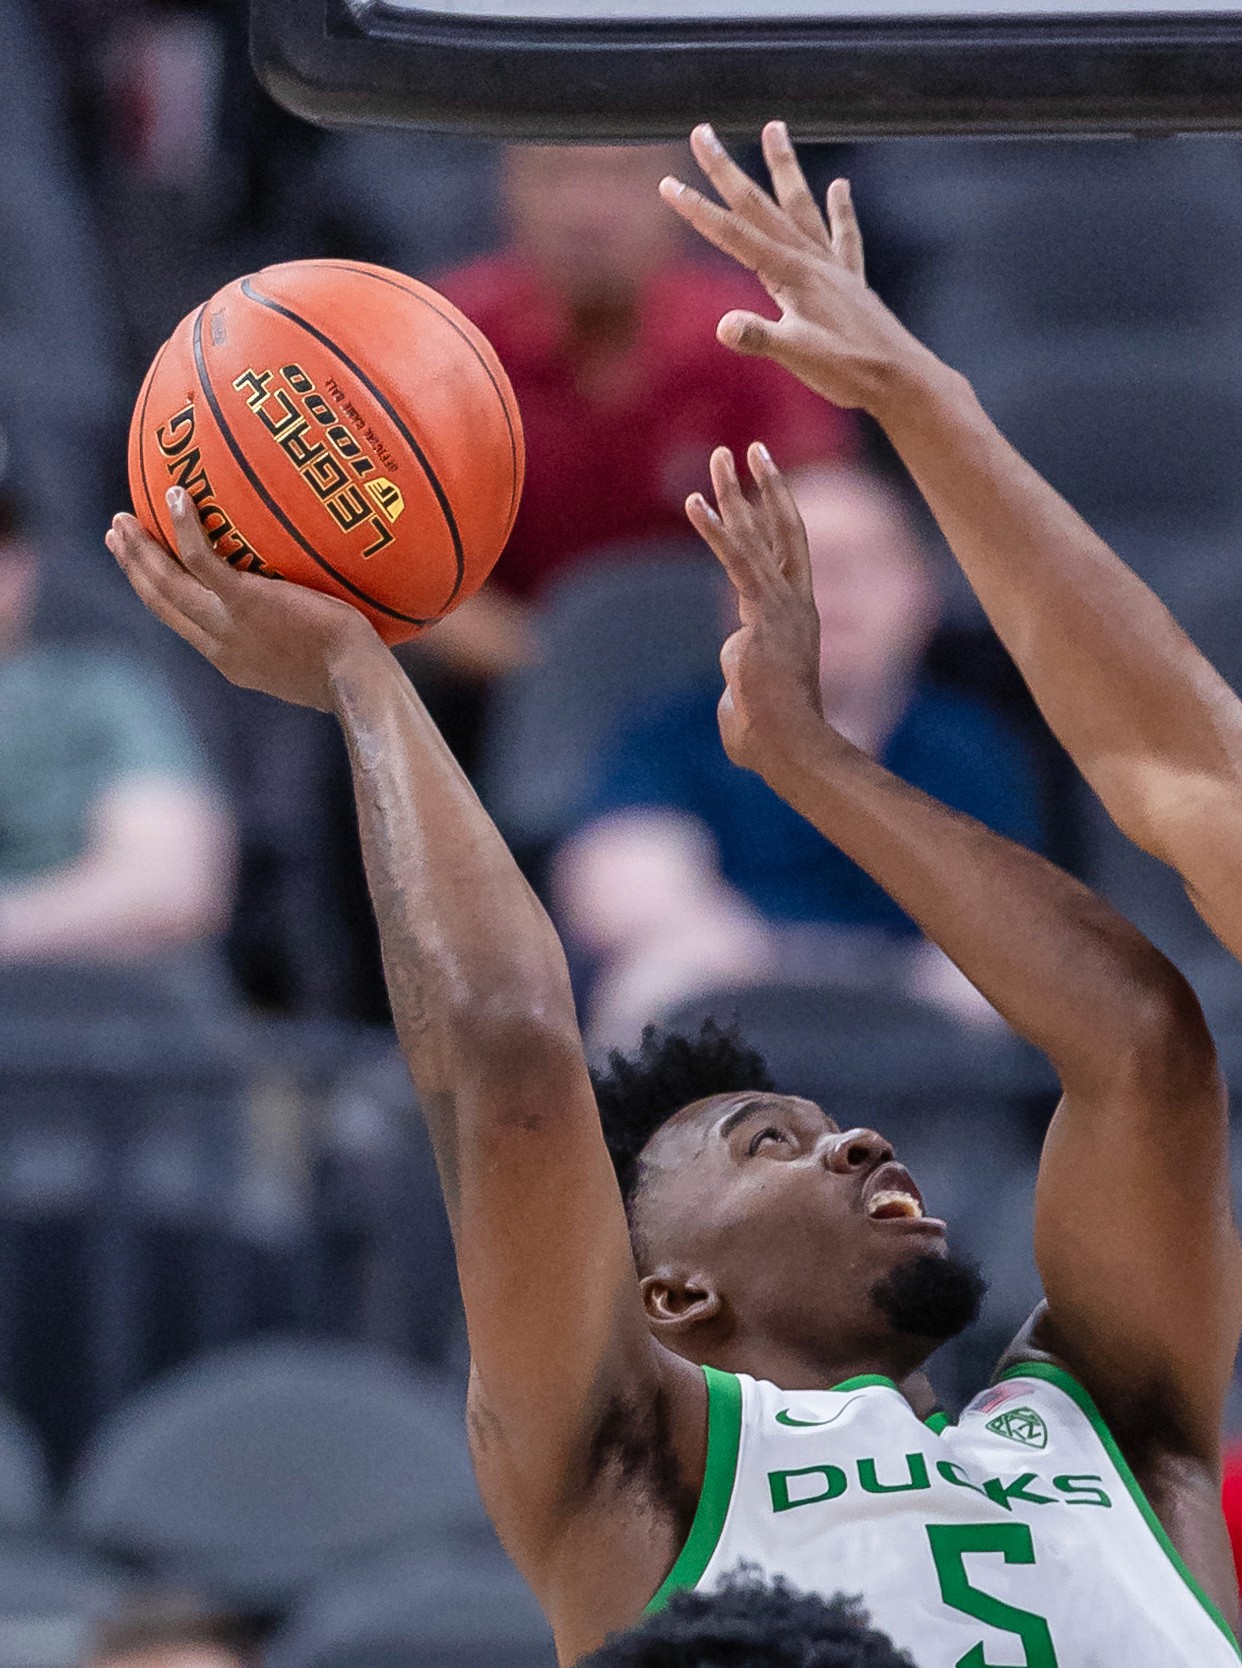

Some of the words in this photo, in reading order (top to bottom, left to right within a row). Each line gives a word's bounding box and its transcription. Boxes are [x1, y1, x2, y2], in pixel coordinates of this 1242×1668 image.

[232, 367, 397, 560] LEGACY
[279, 363, 377, 479] 1000
[767, 1451, 1113, 1513] DUCKS
